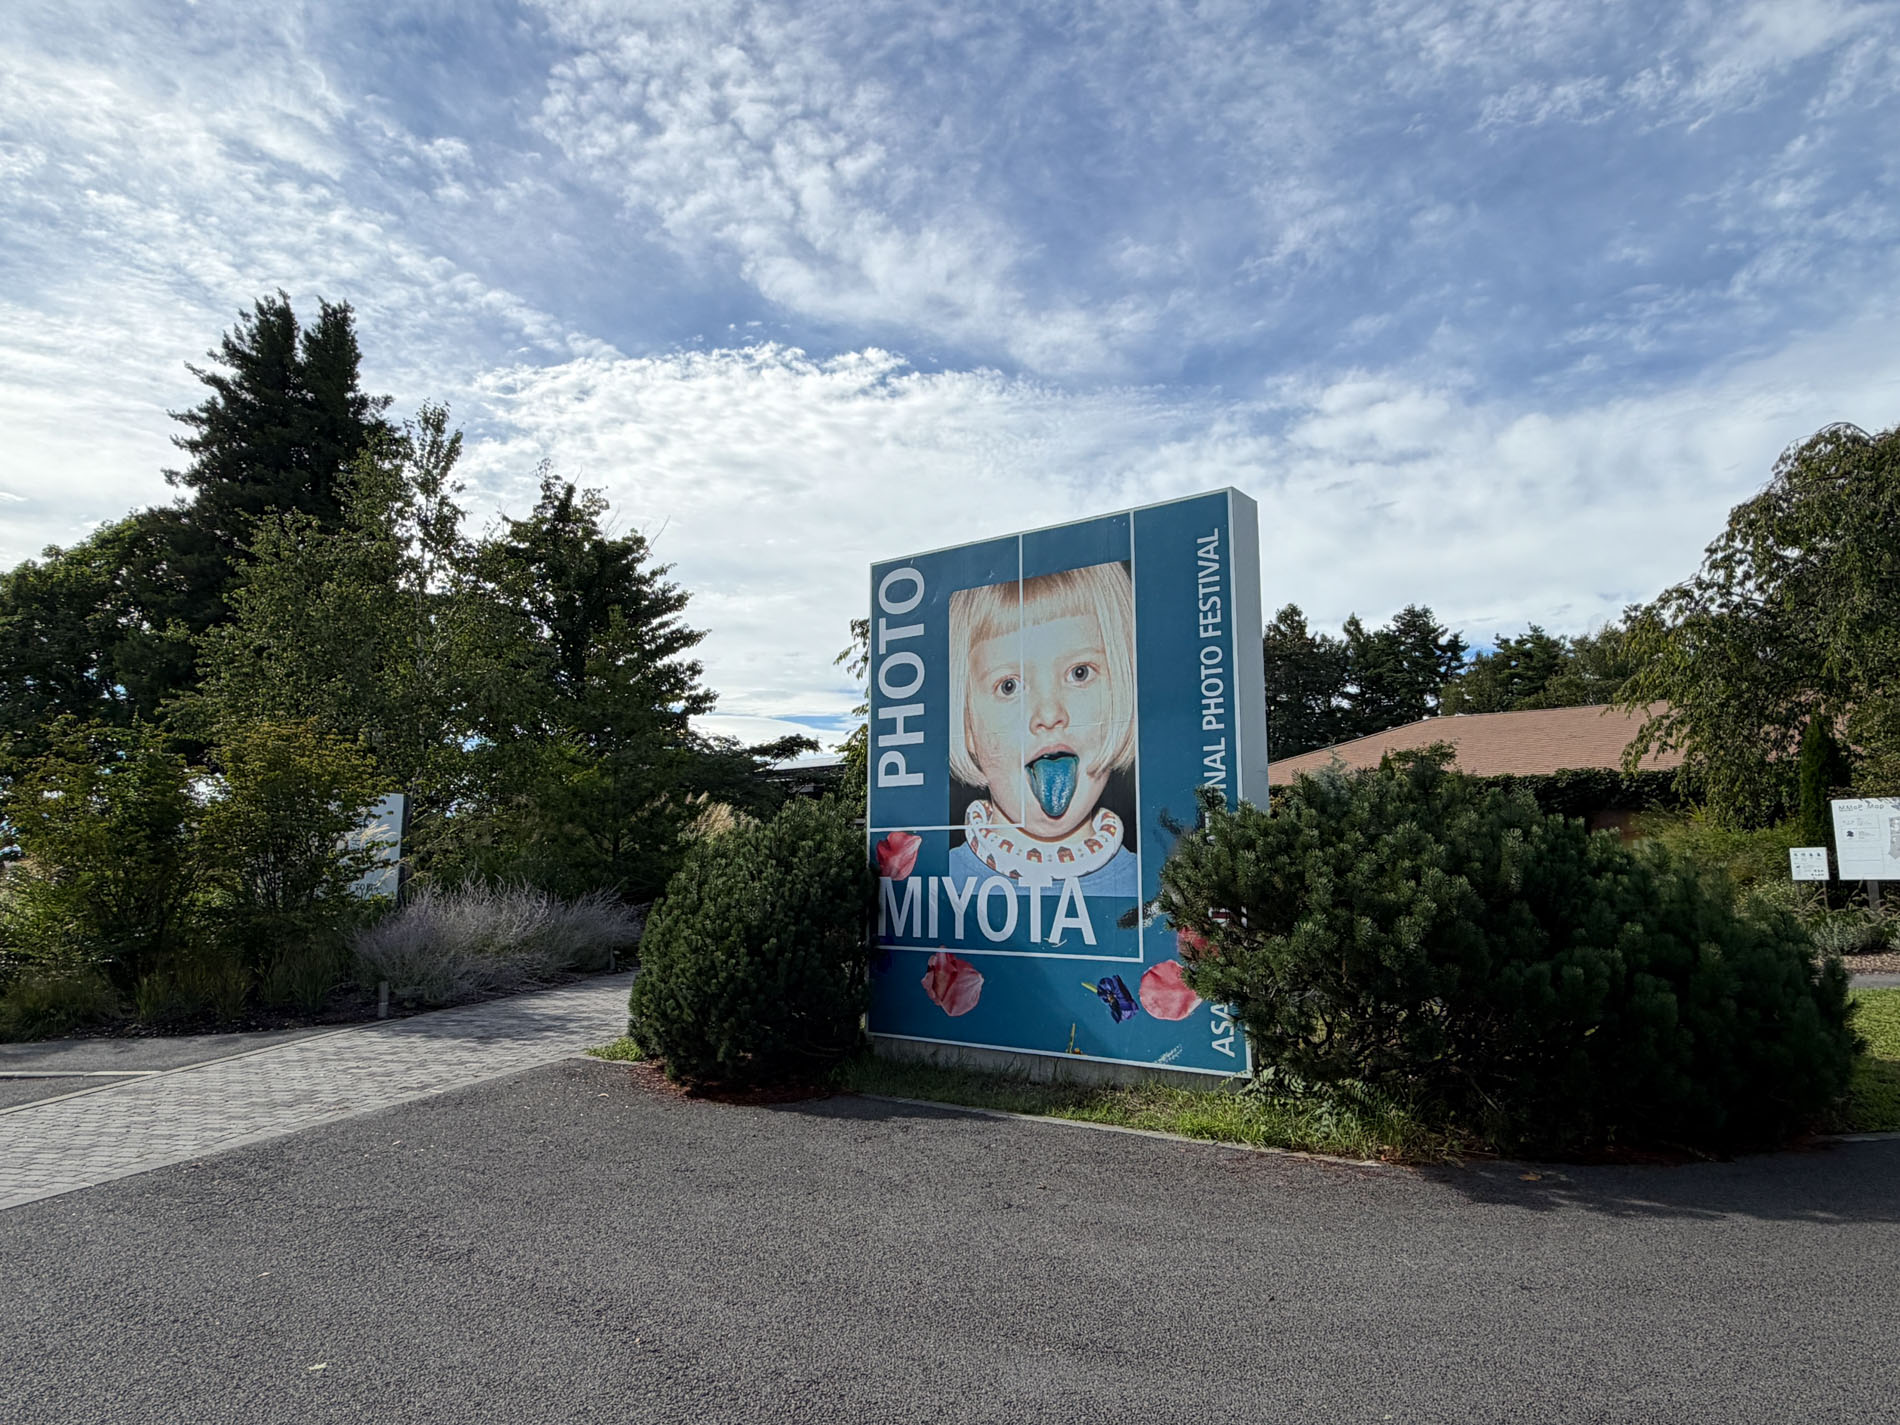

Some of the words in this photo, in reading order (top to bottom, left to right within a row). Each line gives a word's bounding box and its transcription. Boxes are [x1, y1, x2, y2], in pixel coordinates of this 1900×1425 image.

[1197, 528, 1222, 638] FESTIVAL
[878, 567, 925, 788] PHOTO
[1200, 646, 1225, 731] PHOTO
[878, 876, 1097, 945] MIYOTA
